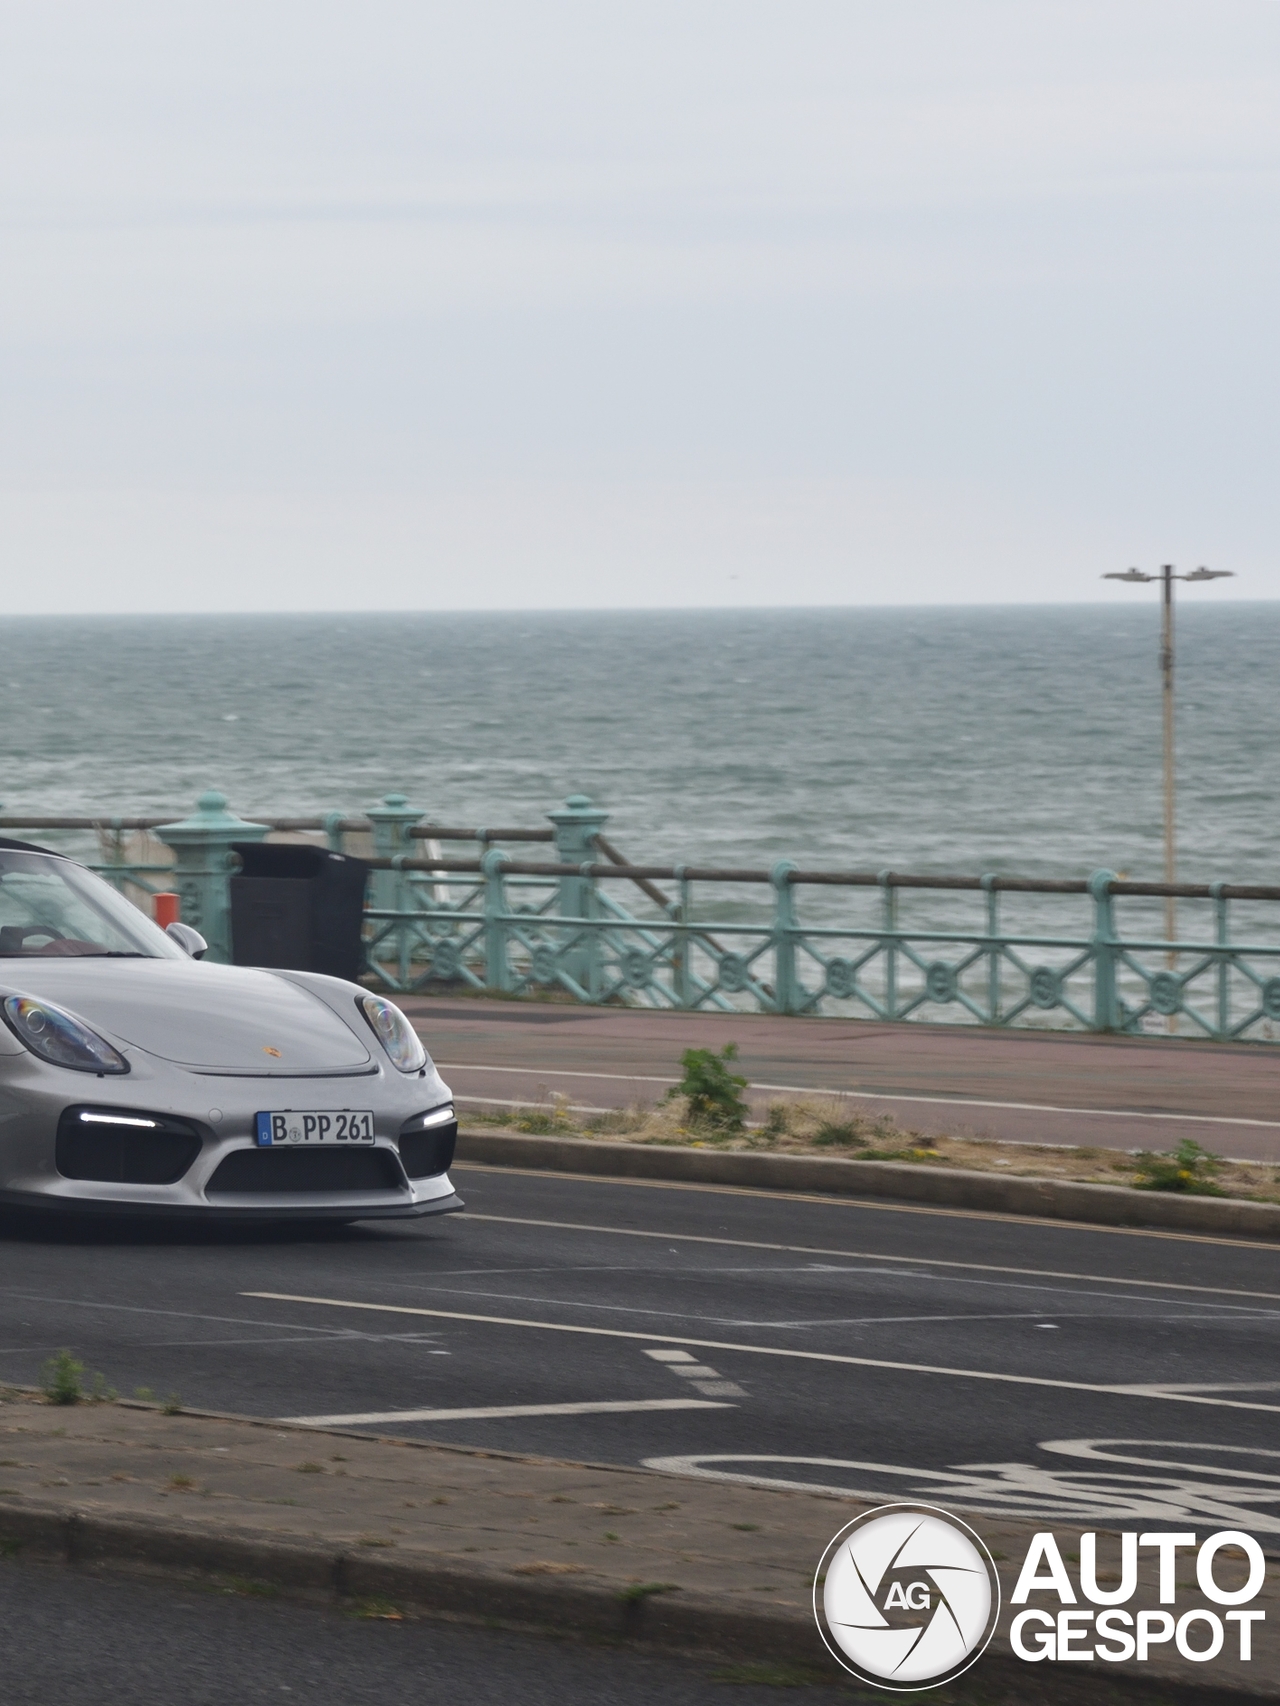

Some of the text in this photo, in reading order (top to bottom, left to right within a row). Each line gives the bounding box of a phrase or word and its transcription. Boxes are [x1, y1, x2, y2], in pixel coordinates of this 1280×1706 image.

[262, 1132, 269, 1140] D
[272, 1114, 373, 1141] B PP 261
